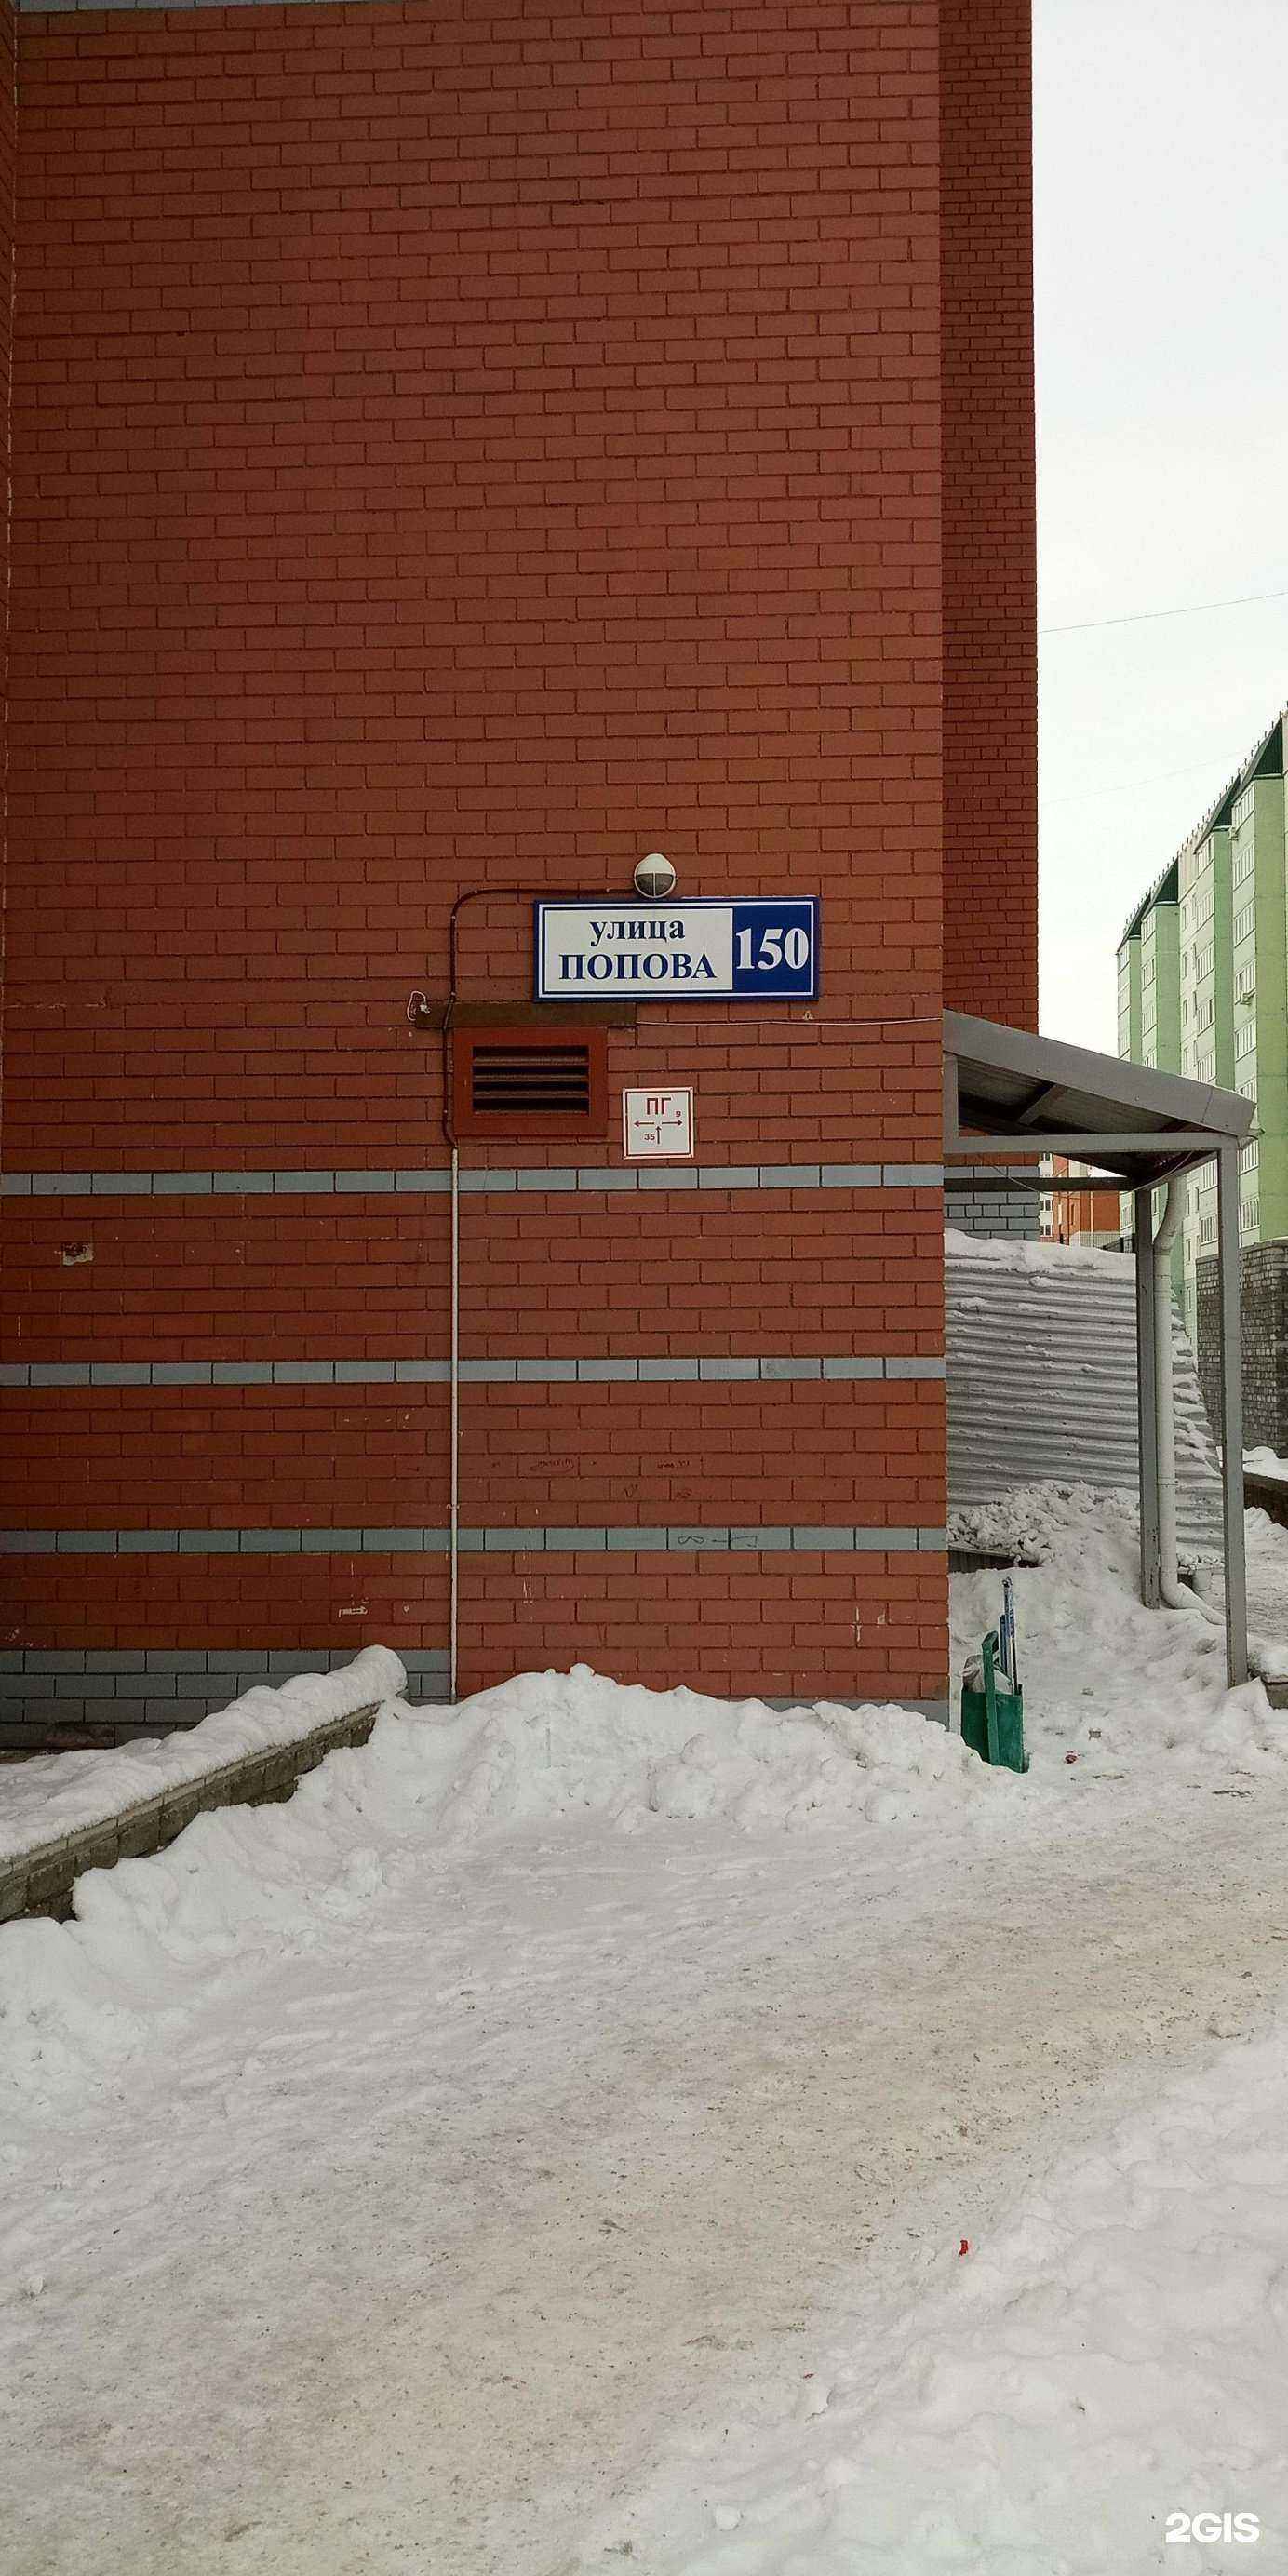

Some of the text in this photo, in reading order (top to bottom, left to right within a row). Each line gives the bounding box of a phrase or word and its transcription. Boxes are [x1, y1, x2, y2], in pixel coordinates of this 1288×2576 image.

[589, 919, 686, 946] улица
[735, 927, 810, 970] 150
[558, 952, 718, 980] ПОПОВА
[646, 1097, 672, 1115] ПГ
[644, 1133, 655, 1141] 35
